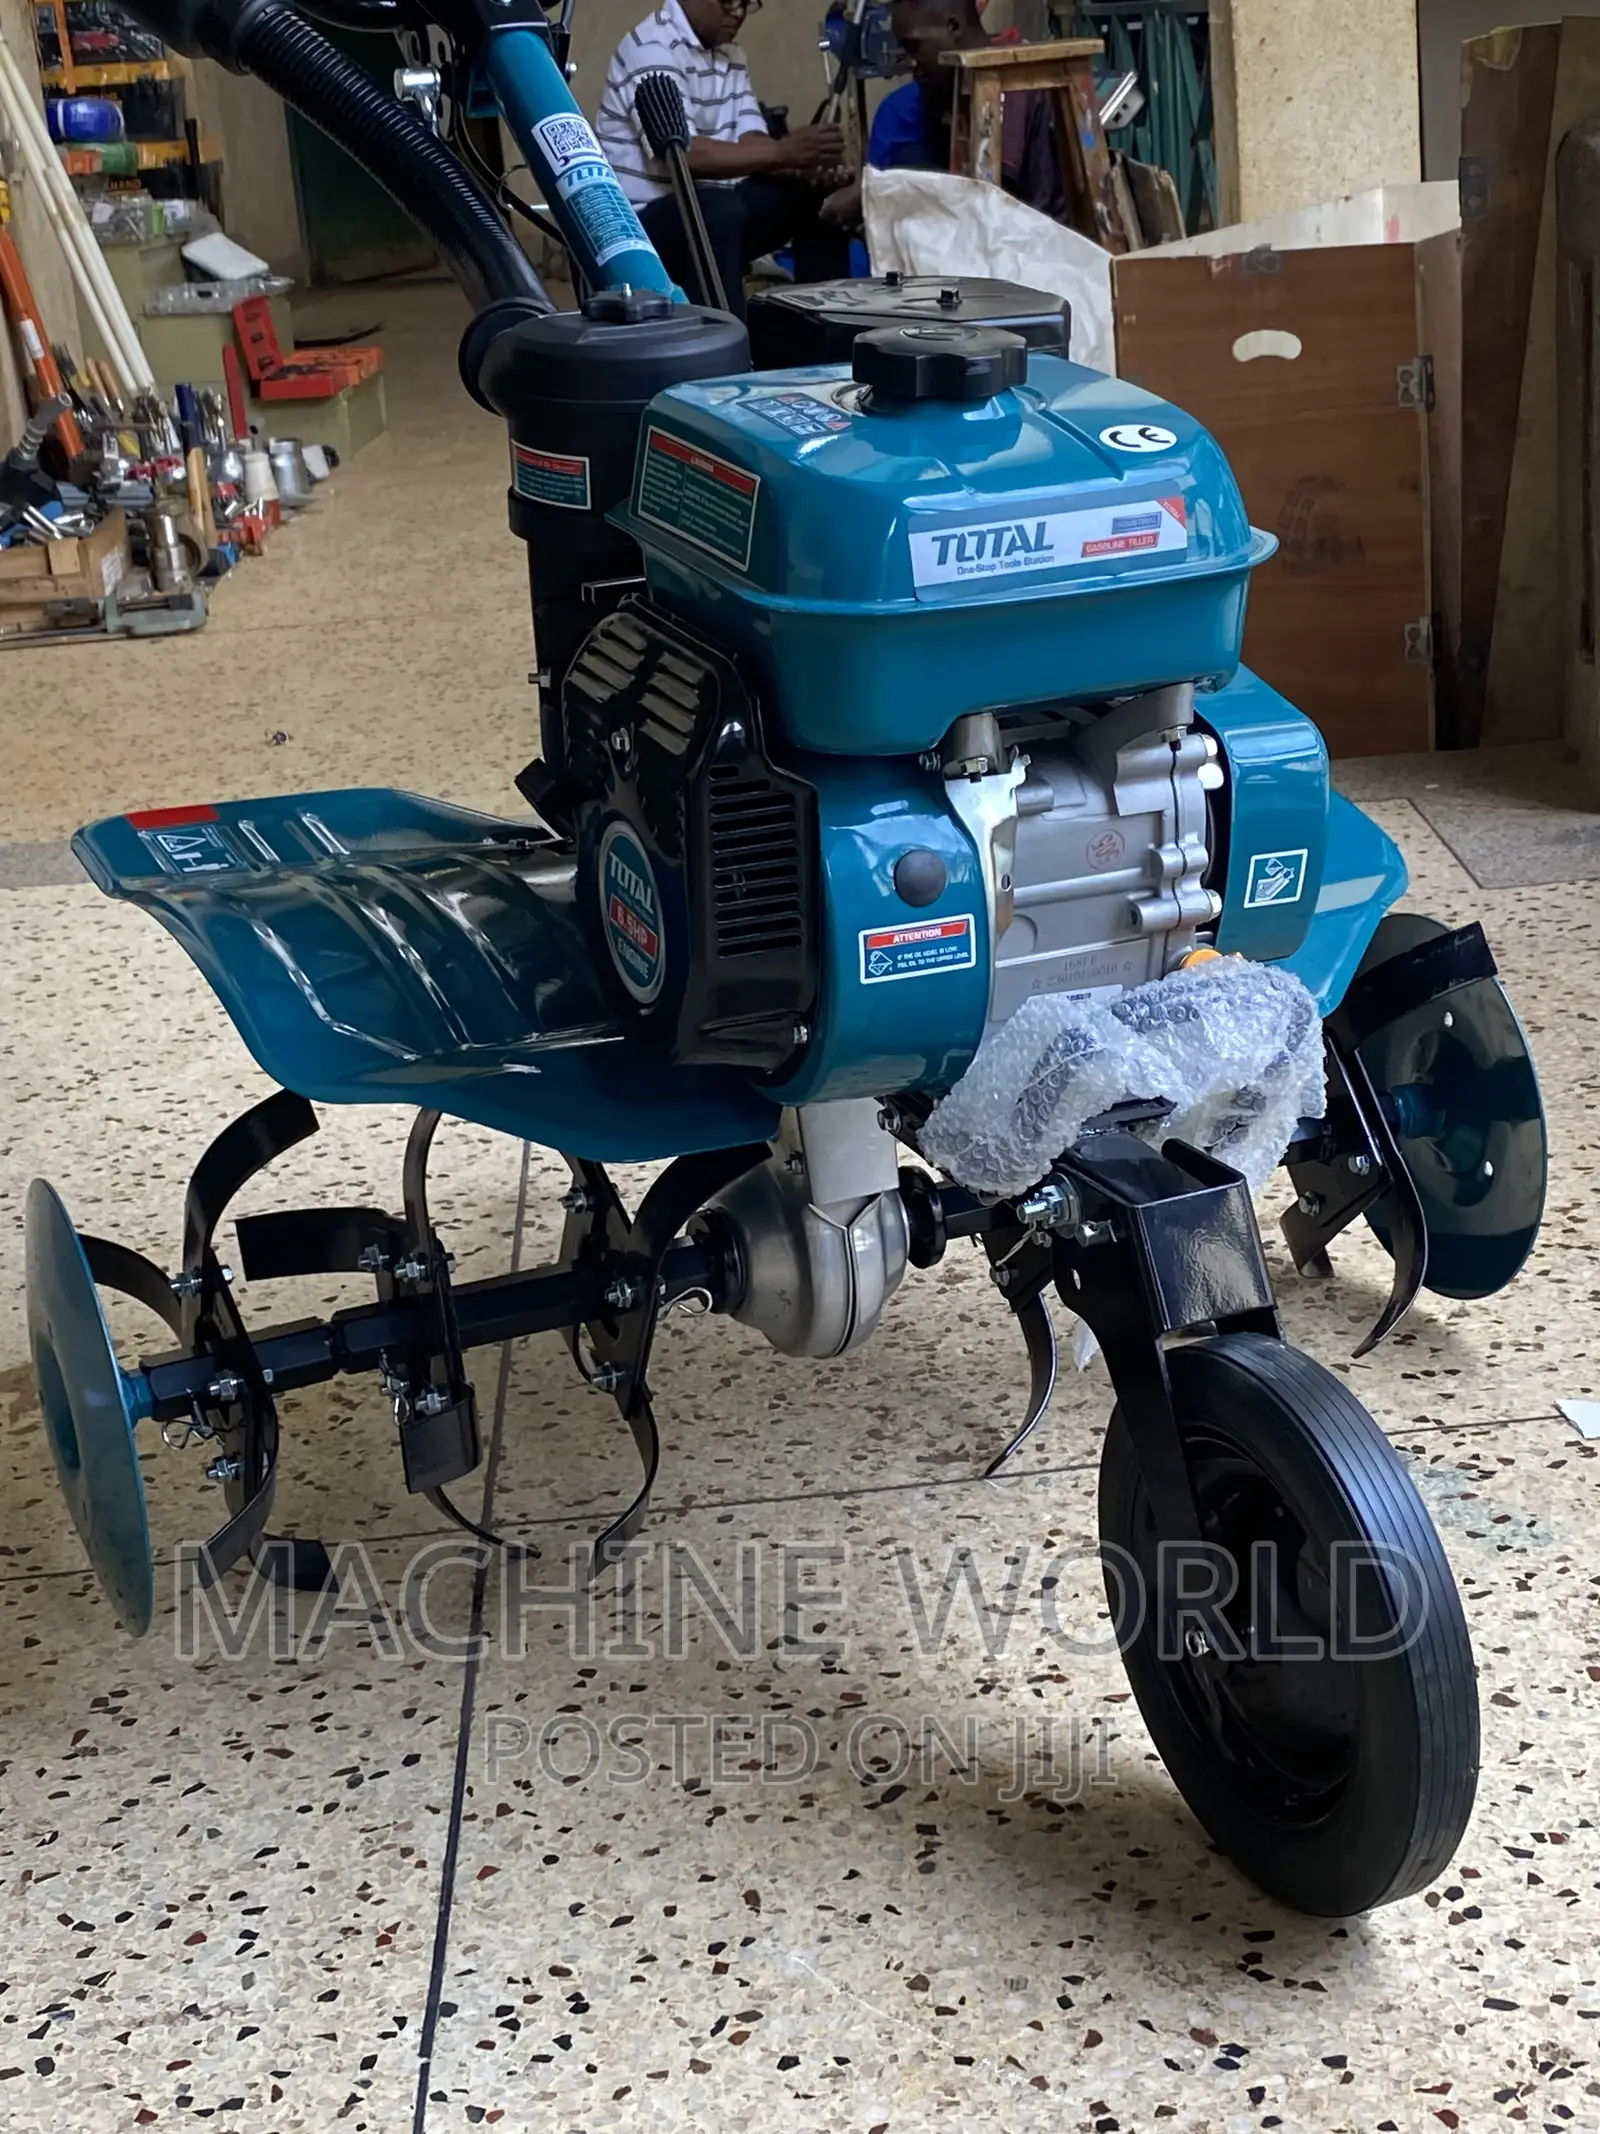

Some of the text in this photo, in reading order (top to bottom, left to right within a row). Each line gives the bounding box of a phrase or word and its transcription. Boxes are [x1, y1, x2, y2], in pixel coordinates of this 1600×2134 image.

[931, 521, 1054, 566] TOTAL
[1085, 536, 1154, 553] GASOLINE TILLER
[957, 554, 1055, 576] One-Stop Tools Station
[609, 851, 654, 915] TOTAL
[616, 904, 649, 945] 6.5HP
[893, 928, 942, 943] ATTENTION
[617, 936, 649, 979] ENGINE
